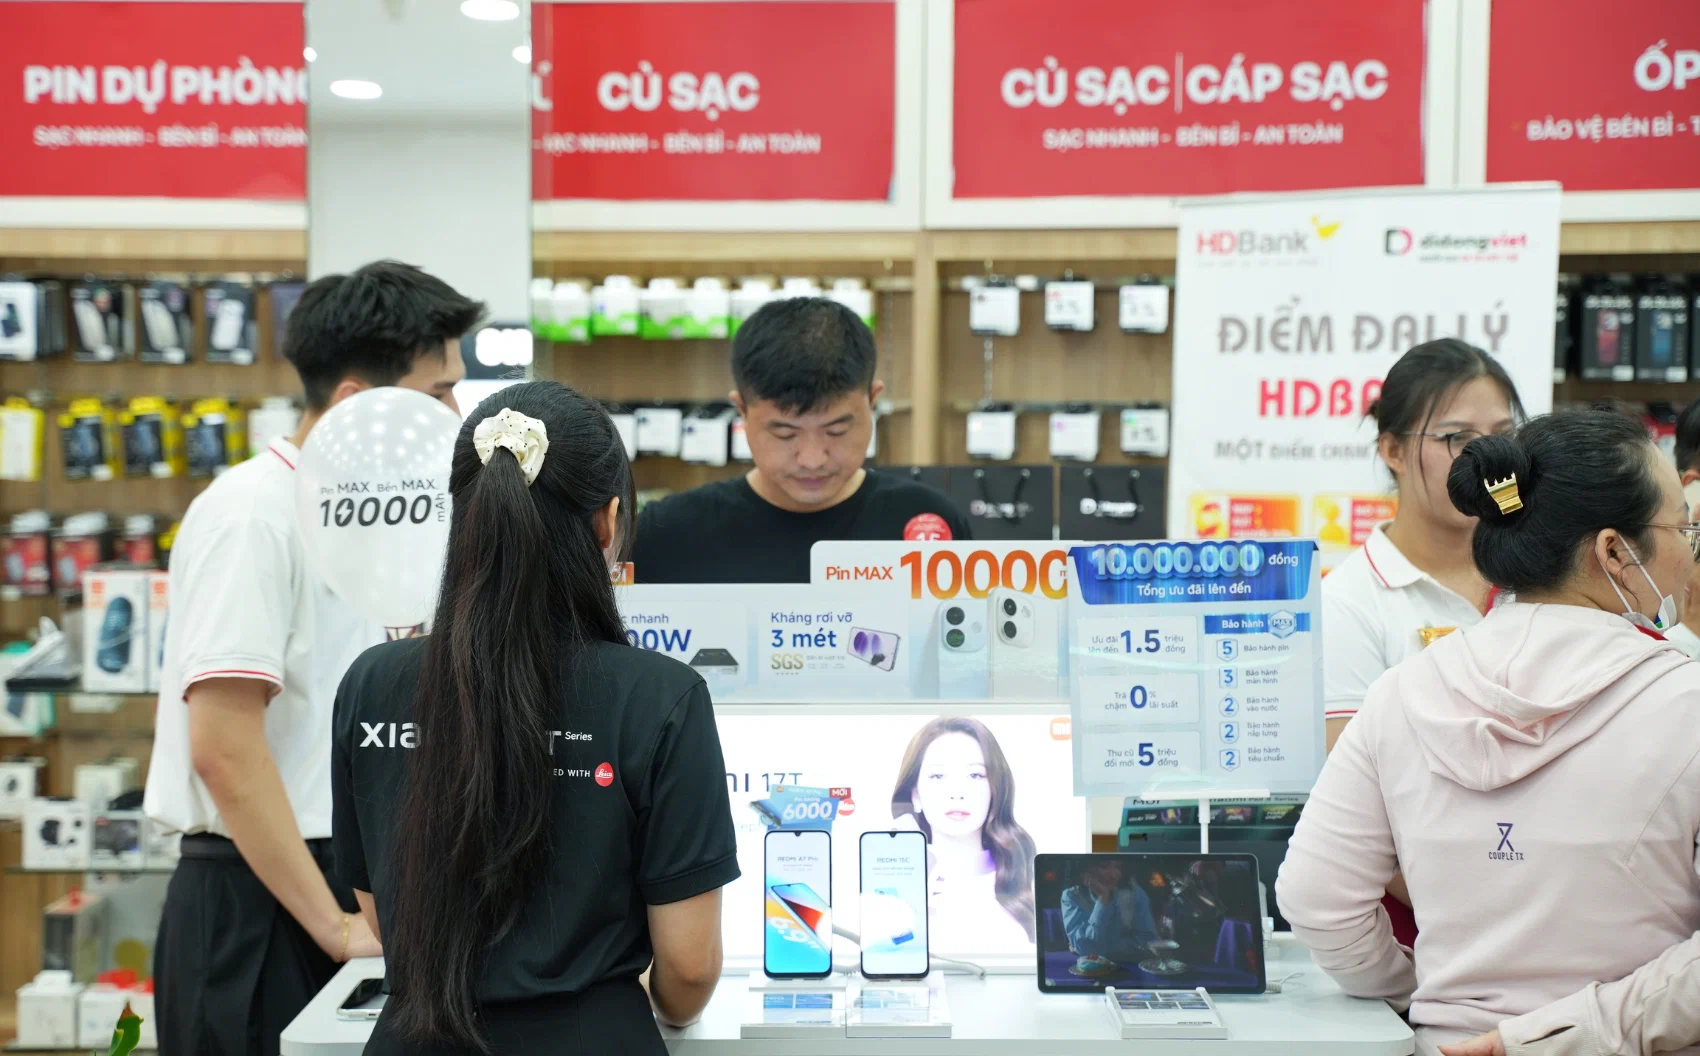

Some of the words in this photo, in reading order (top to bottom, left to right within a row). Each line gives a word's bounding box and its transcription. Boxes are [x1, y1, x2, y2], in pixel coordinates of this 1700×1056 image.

[1634, 38, 1700, 91] ỐP
[24, 64, 97, 104] PIN
[102, 59, 167, 114] DỰ
[596, 60, 663, 112] CỦ
[668, 71, 760, 121] SẠC
[1001, 55, 1068, 108] CỦ
[1075, 66, 1170, 115] SẠC
[1185, 52, 1283, 104] CÁP
[1290, 59, 1388, 111] SẠC
[1526, 114, 1573, 141] BẢO
[1606, 112, 1649, 138] BỀN
[1043, 128, 1084, 152] SẠC
[1253, 125, 1283, 144] AN
[1196, 230, 1309, 254] HDBank
[1217, 295, 1335, 353] ĐIỂM
[320, 494, 432, 527] 10000
[435, 493, 446, 522] mAh
[1092, 543, 1261, 576] 10.000.000
[1268, 551, 1299, 566] đồng
[825, 566, 851, 581] Pin
[853, 566, 893, 581] MAX
[900, 549, 1068, 600] 10000
[1137, 583, 1166, 598] Tổng
[1169, 585, 1184, 596] ưu
[1186, 583, 1205, 595] đãi
[1208, 583, 1226, 594] lên
[1229, 581, 1251, 594] đến
[631, 613, 670, 624] nhanh
[771, 610, 812, 626] Kháng
[816, 611, 833, 623] rơi
[837, 611, 853, 623] vỡ
[1222, 619, 1239, 629] Bảo
[1241, 619, 1264, 628] hành
[625, 628, 692, 652] 00W
[771, 629, 784, 648] 3
[792, 627, 837, 648] mét
[1120, 629, 1161, 653] 1.5
[1223, 641, 1232, 655] 5
[771, 653, 804, 670] SGS
[1224, 669, 1233, 684] 3
[1104, 702, 1127, 711] chậm
[1130, 685, 1147, 709] 0
[1224, 697, 1234, 712] 2
[565, 731, 593, 741] Series
[1224, 724, 1234, 738] 2
[1138, 743, 1155, 767] 5
[1225, 751, 1235, 766] 2
[567, 769, 590, 778] WITH
[783, 800, 833, 820] 6000
[1488, 851, 1514, 861] COUPLE
